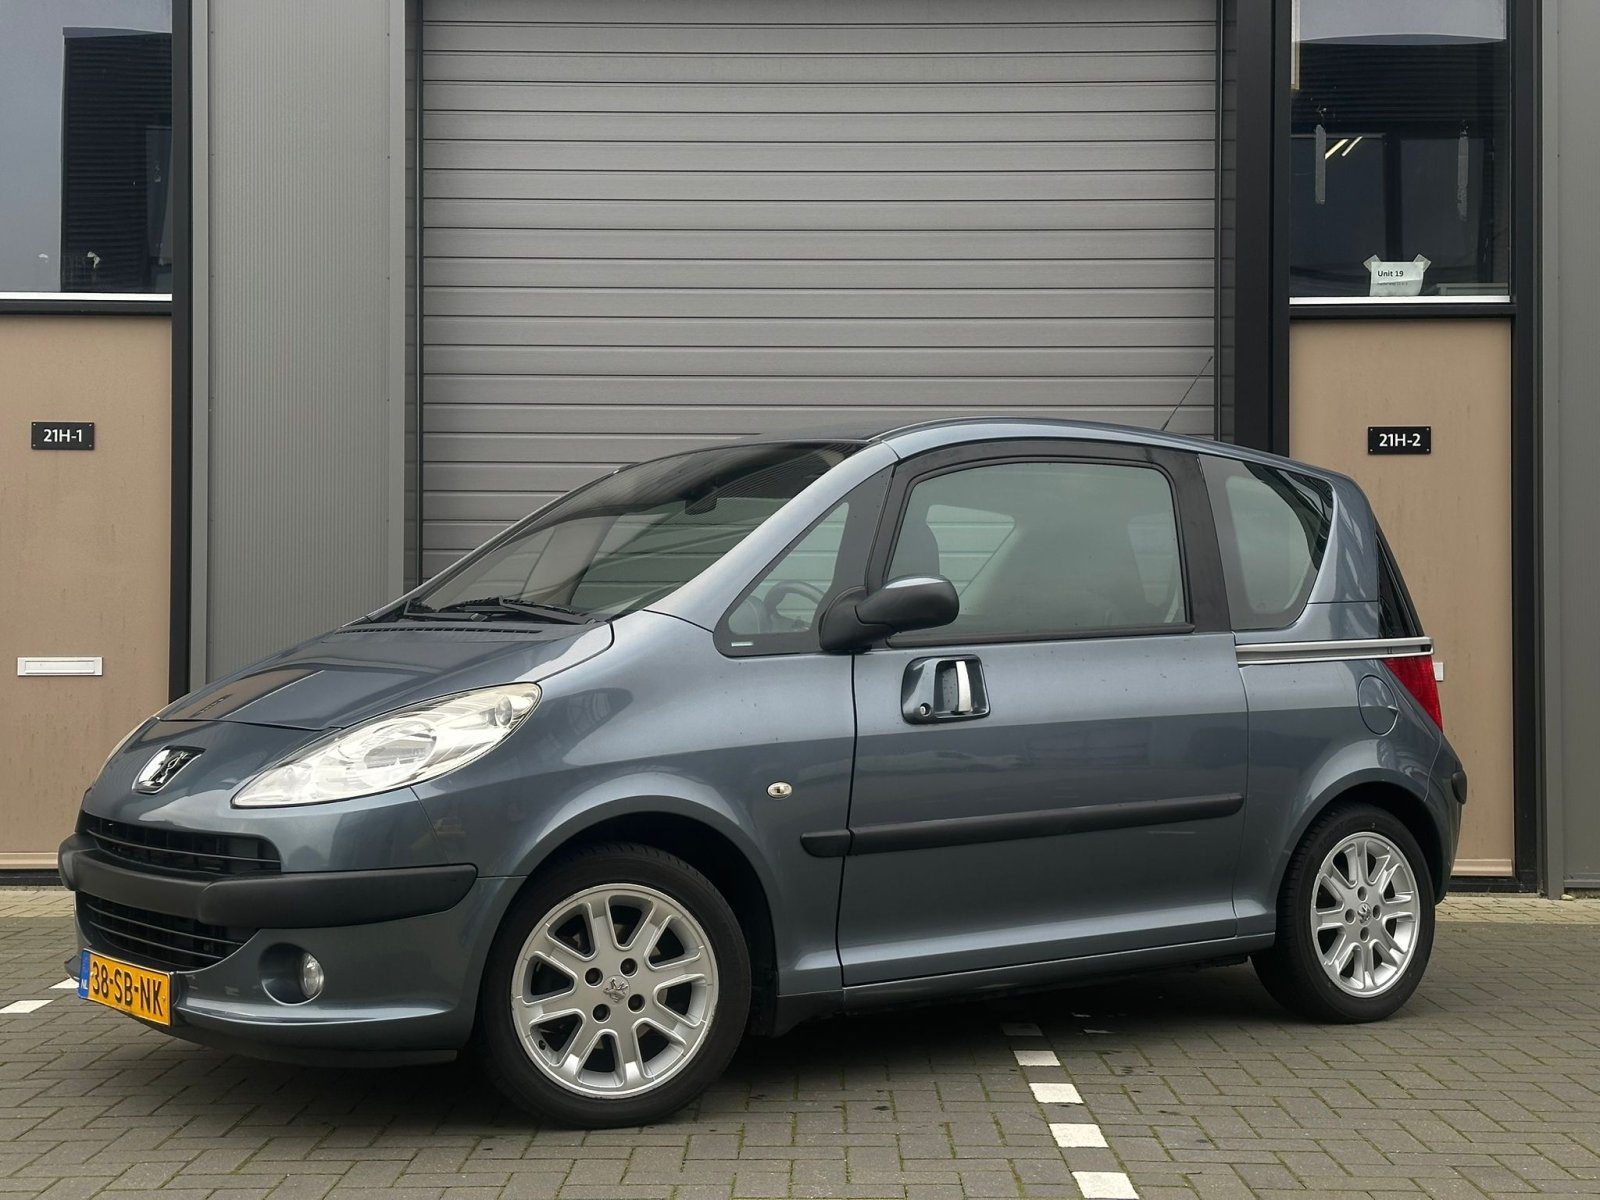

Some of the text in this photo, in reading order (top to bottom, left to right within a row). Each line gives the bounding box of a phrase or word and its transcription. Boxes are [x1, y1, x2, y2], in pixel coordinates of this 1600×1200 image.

[43, 428, 82, 442] 21H-1
[1379, 433, 1421, 447] 21H-2
[80, 961, 163, 1017] NL 38-SB-NK
